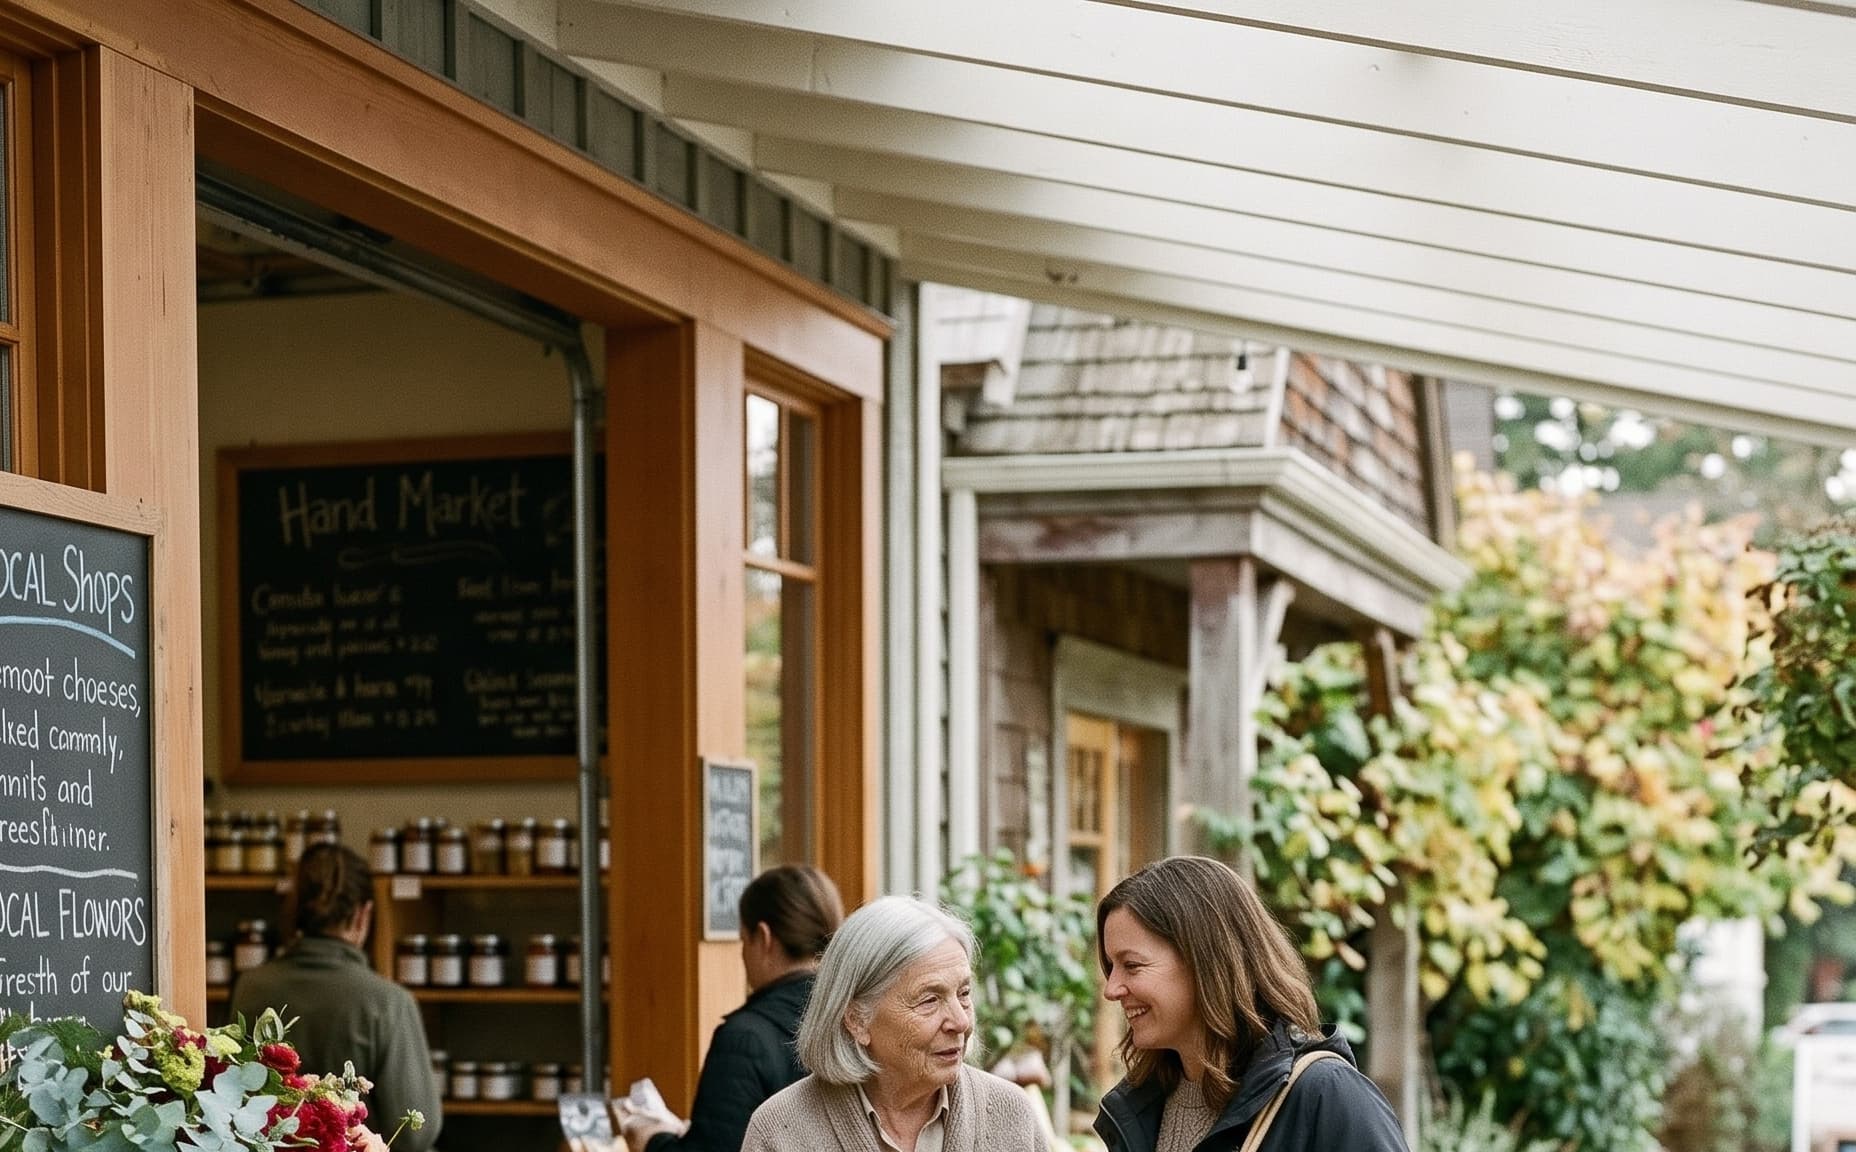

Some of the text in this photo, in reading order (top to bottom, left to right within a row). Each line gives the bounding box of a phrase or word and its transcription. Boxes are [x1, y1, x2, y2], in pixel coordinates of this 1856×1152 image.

[278, 469, 526, 548] Hand Market
[0, 656, 141, 718] moot choeses,
[0, 707, 39, 750] lked
[58, 768, 93, 808] and
[59, 888, 146, 946] FLOWORS
[71, 955, 90, 994] of
[102, 970, 132, 993] our
